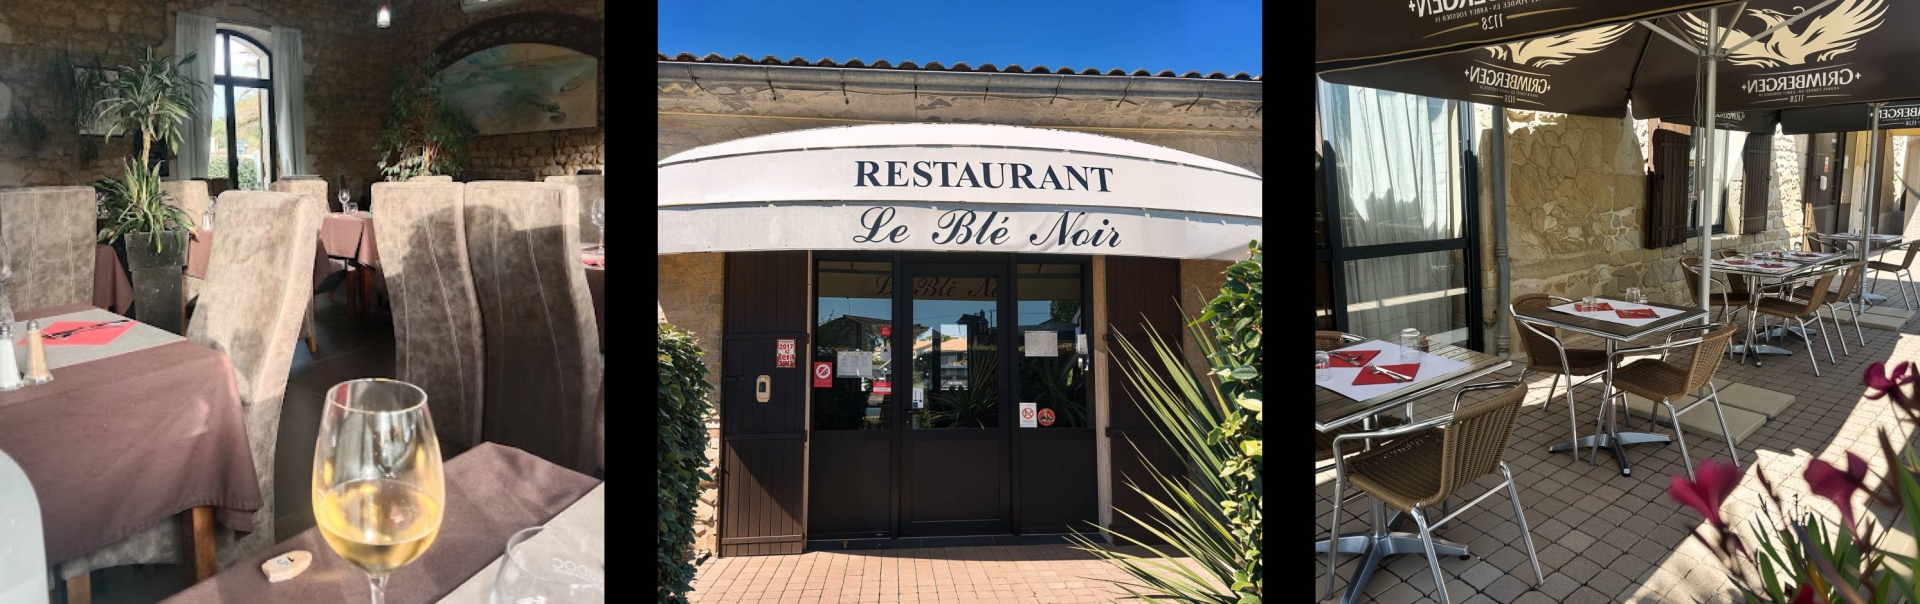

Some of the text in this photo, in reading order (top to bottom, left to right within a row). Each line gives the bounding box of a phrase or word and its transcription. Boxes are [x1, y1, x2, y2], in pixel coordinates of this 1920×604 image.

[854, 160, 1114, 193] RESTAURANT
[852, 206, 1121, 248] Le Blé Noir
